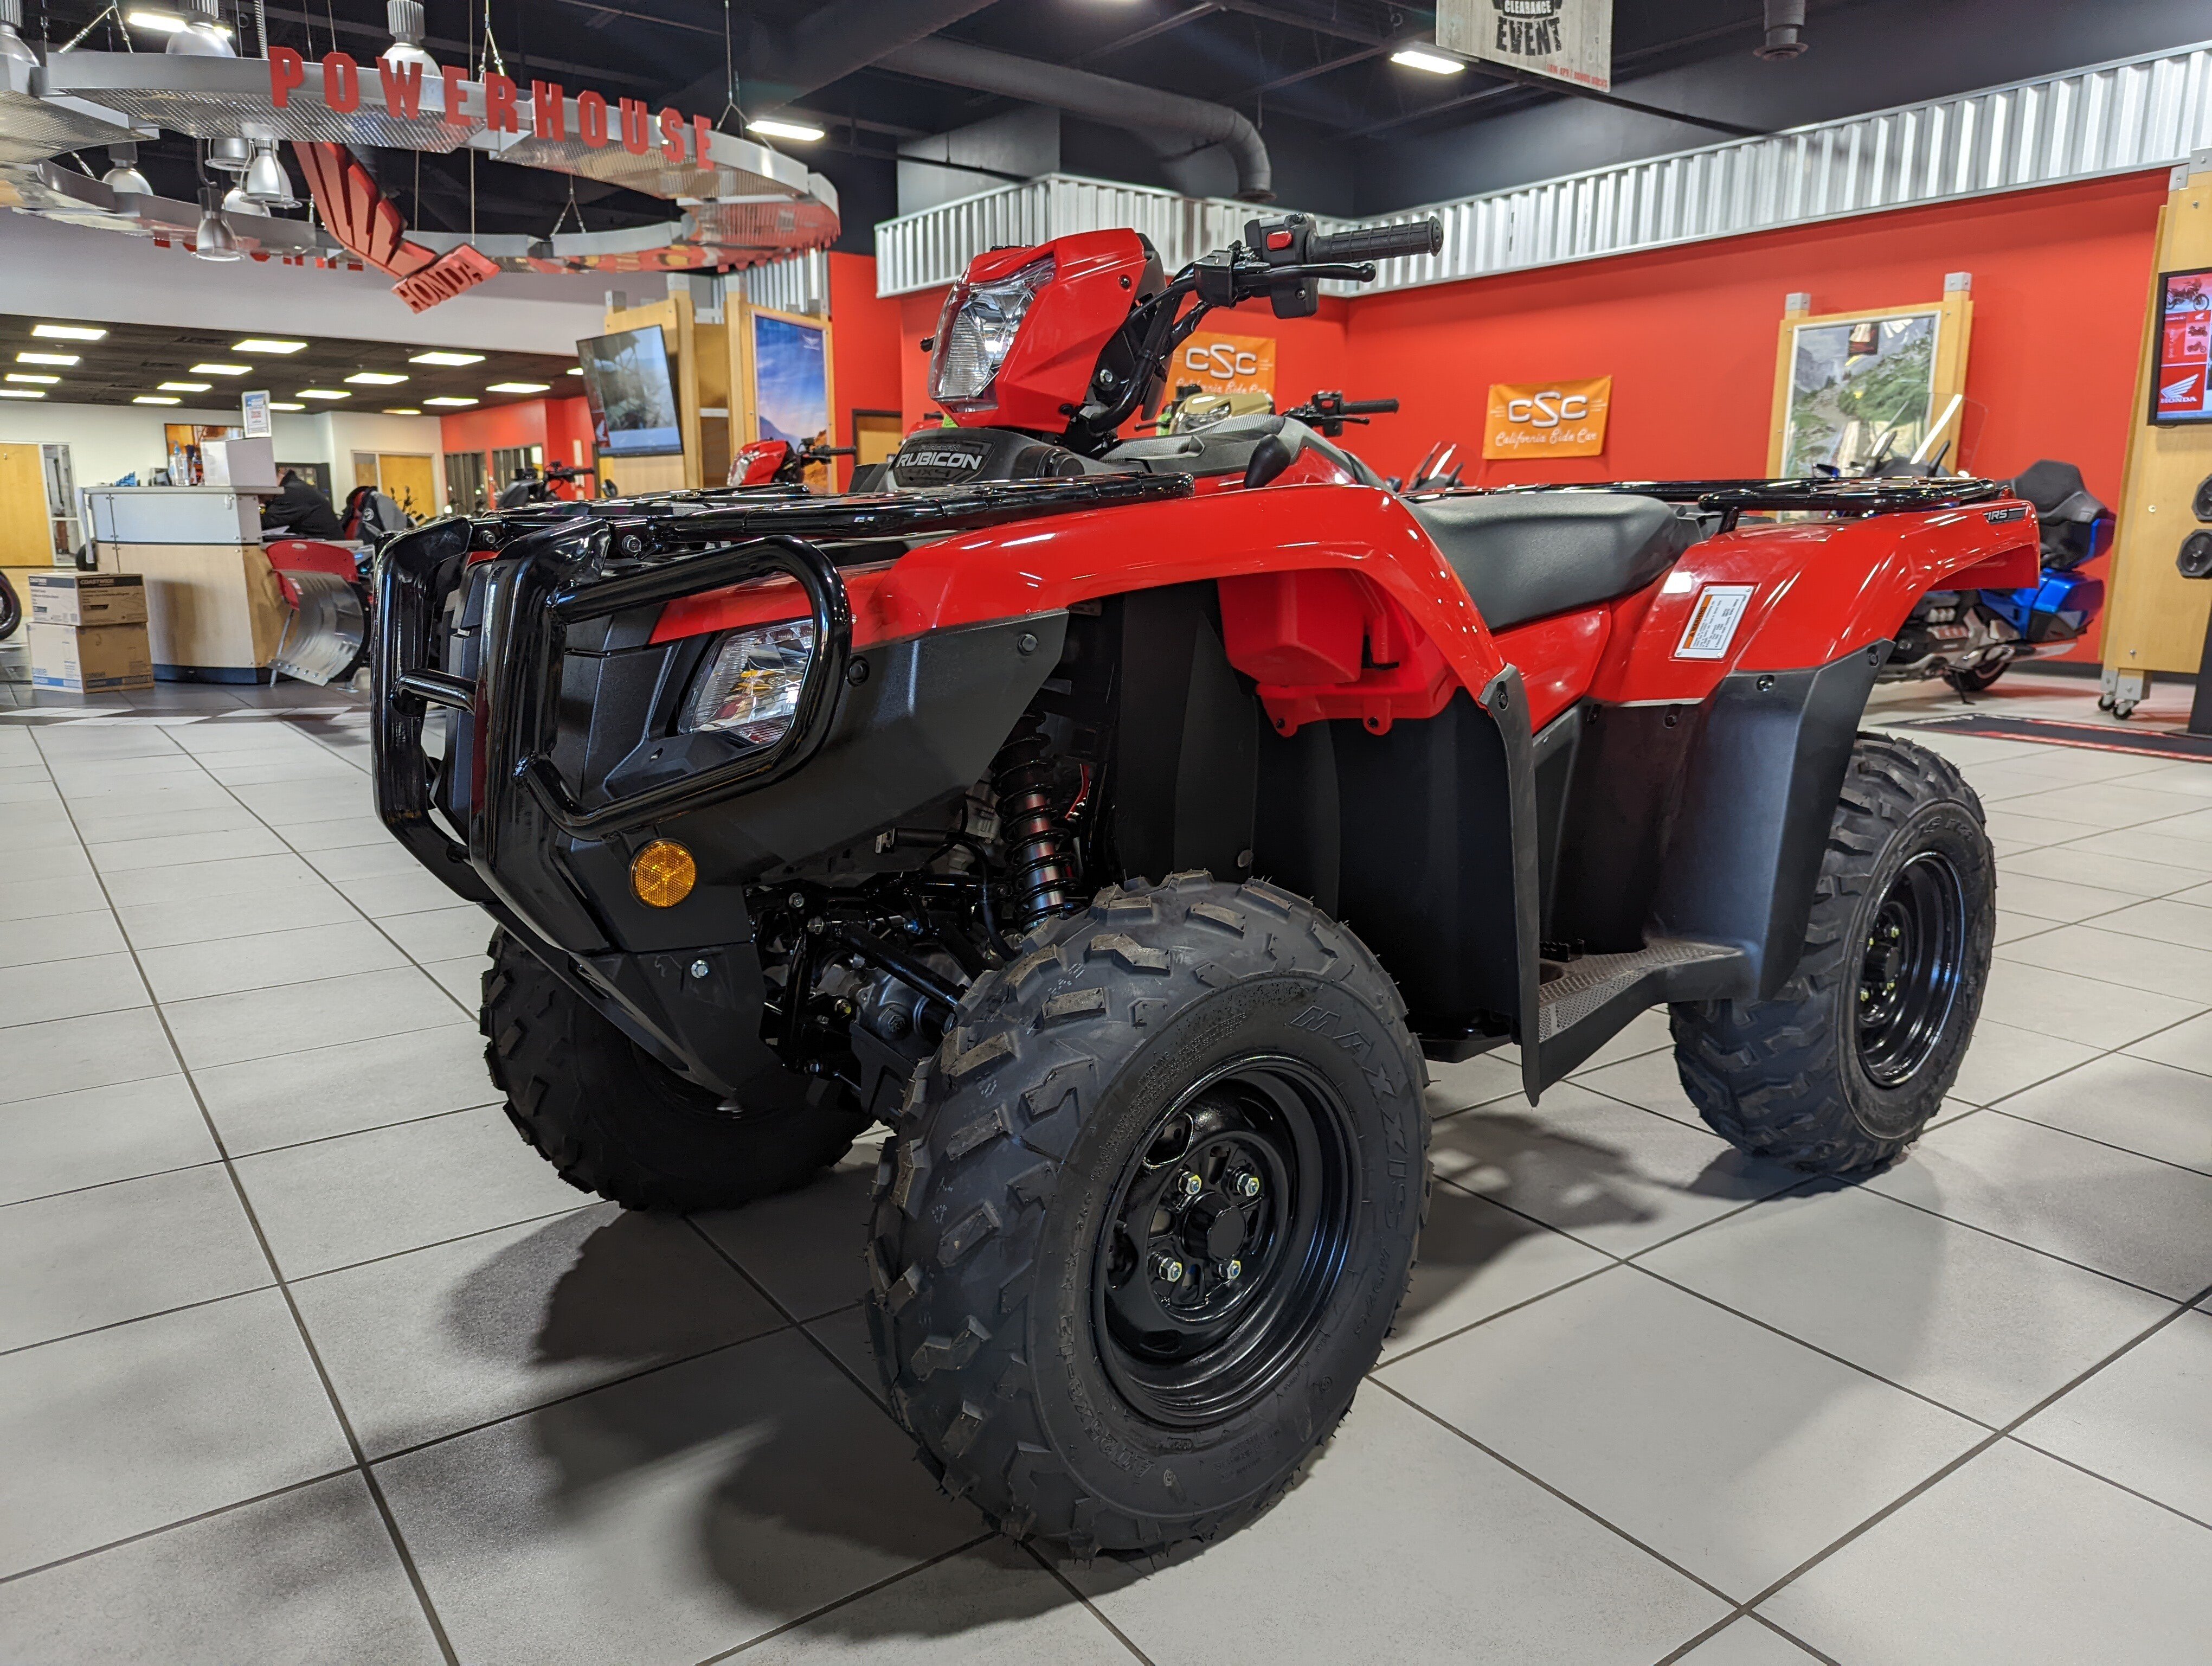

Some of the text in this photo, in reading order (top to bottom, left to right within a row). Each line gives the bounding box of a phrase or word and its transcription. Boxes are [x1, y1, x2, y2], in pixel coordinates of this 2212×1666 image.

[1495, 16, 1562, 56] EVENT
[268, 46, 715, 170] POWERHOUSE
[391, 256, 487, 314] HONDA
[896, 452, 983, 470] RUBICON
[1495, 427, 1597, 449] California Side Car
[1290, 1005, 1409, 1230] MAXXIS
